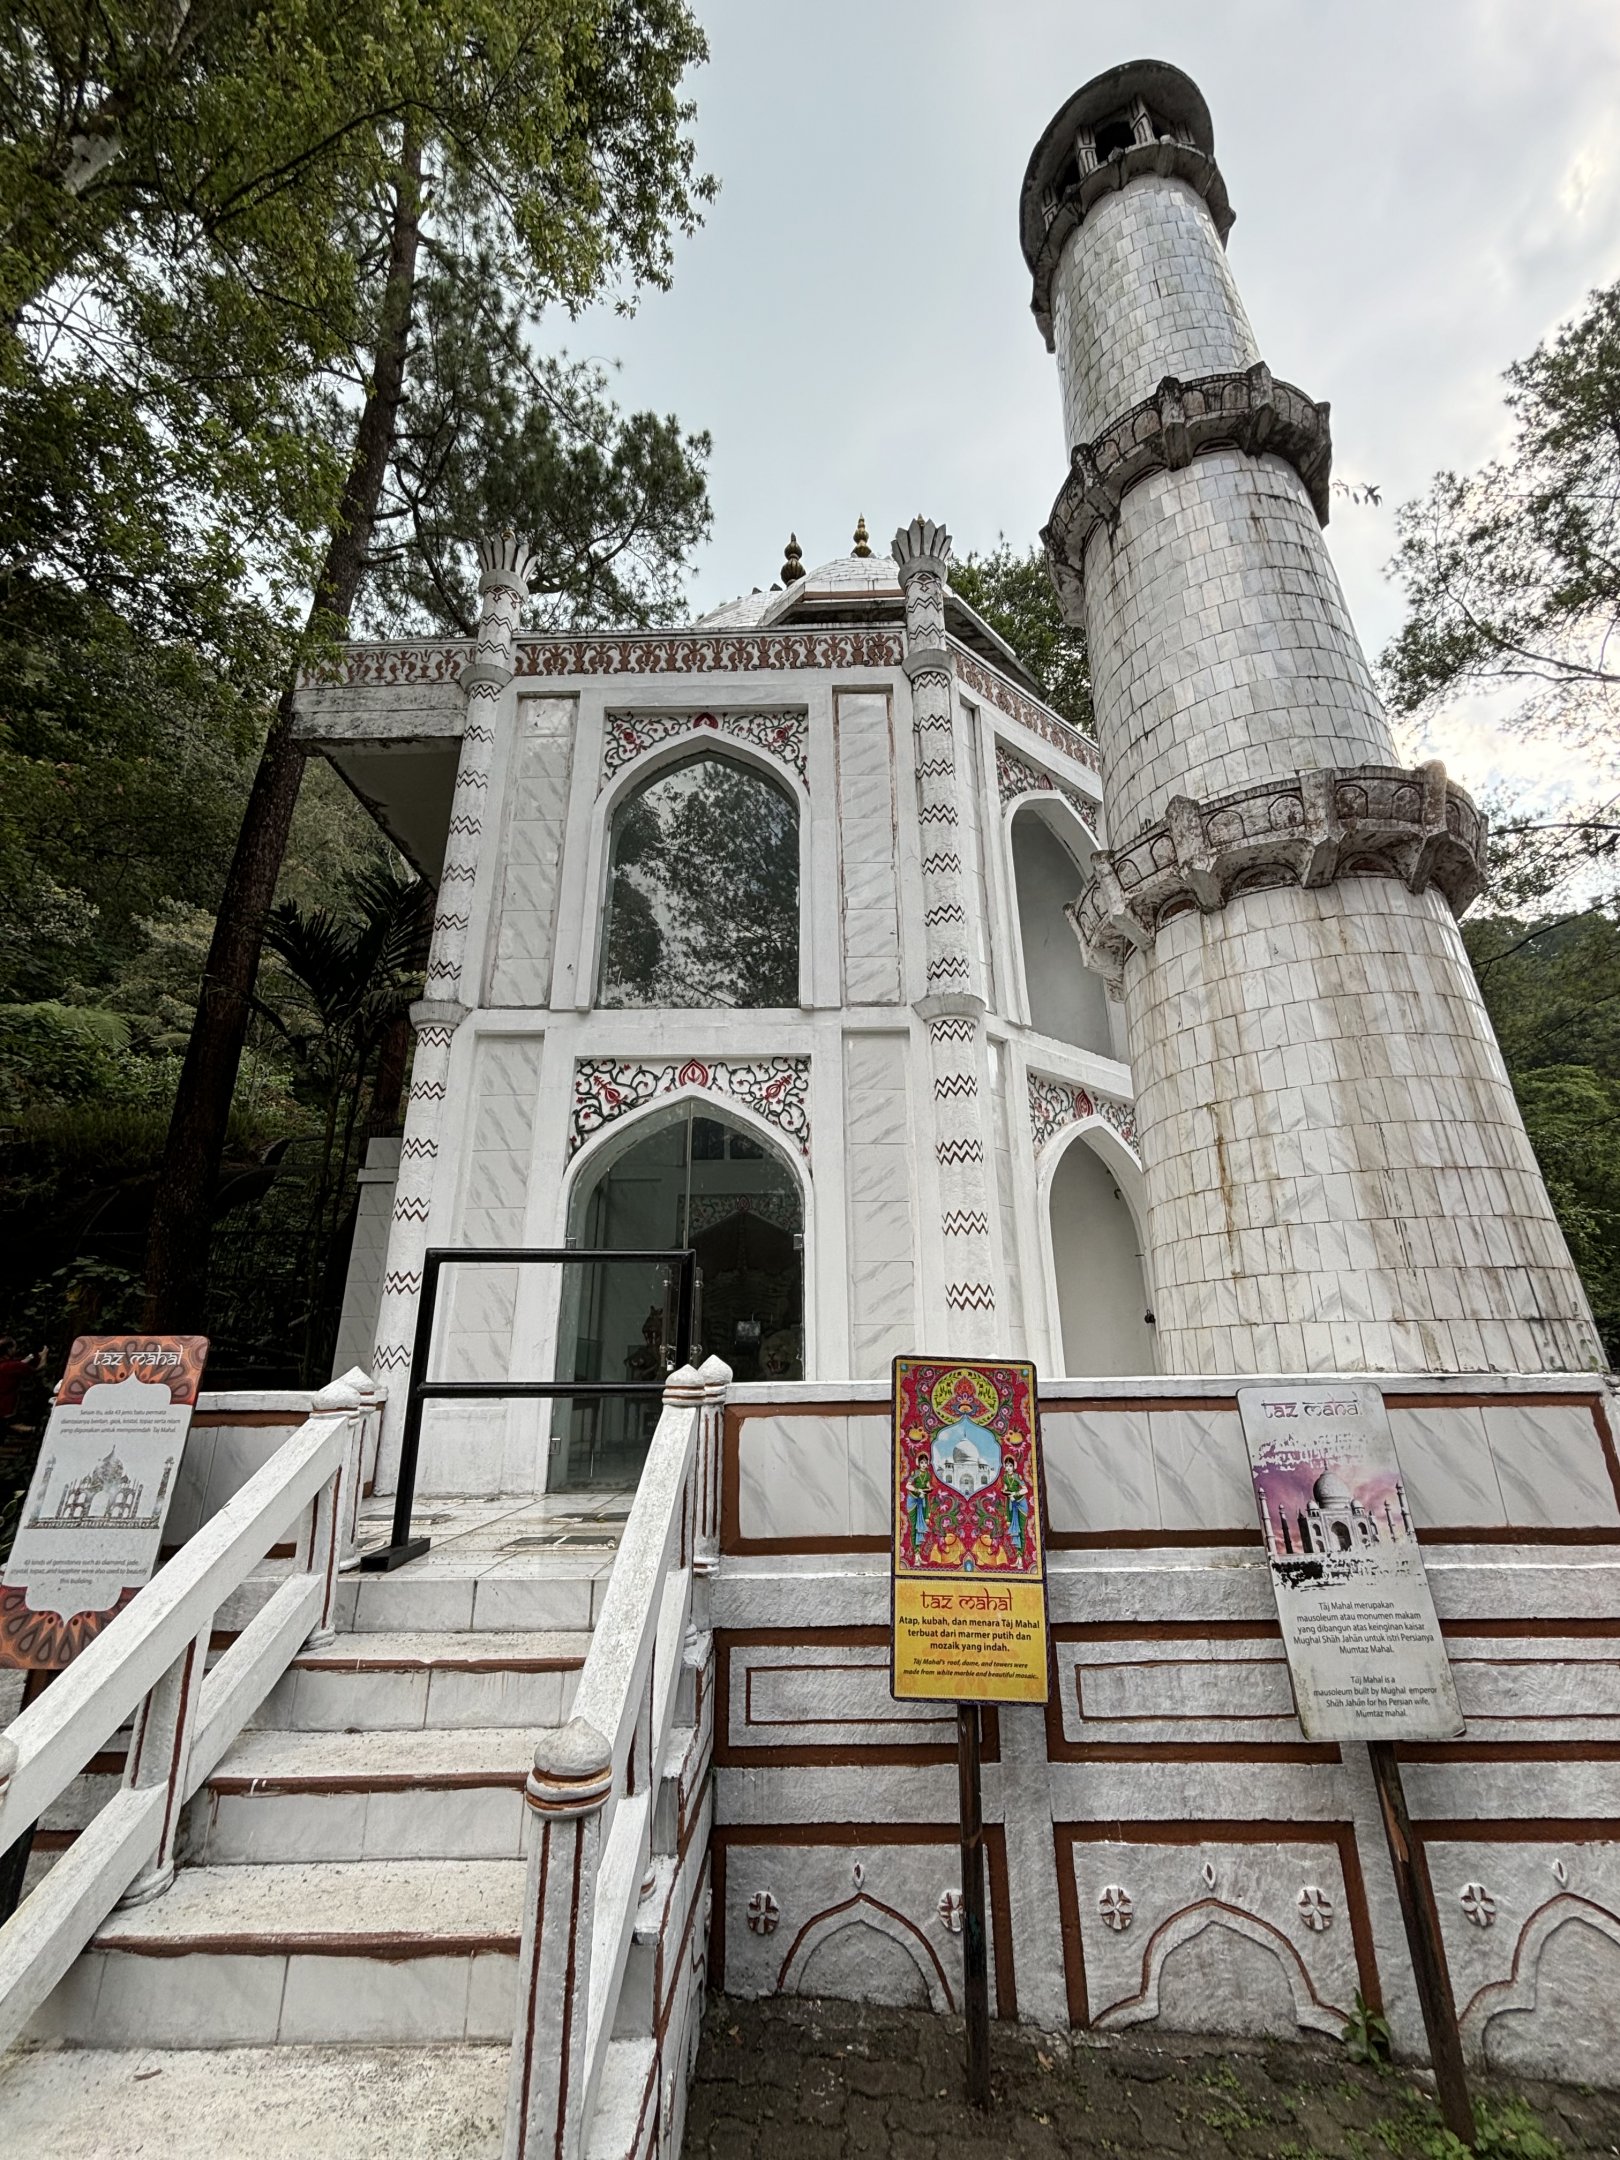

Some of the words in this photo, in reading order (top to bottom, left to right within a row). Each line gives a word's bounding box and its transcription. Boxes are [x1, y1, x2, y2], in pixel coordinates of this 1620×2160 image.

[93, 1350, 126, 1366] taz
[130, 1345, 184, 1366] mahal
[920, 1591, 953, 1609] taz
[959, 1587, 1013, 1611] mahal
[1331, 1602, 1353, 1610] Mahal
[1354, 1601, 1394, 1611] merupakan
[899, 1616, 919, 1626] Atap,
[922, 1616, 949, 1627] kubah,
[952, 1617, 967, 1626] dan
[1015, 1620, 1040, 1629] Mahal
[1297, 1613, 1338, 1622] mausoleum
[1395, 1611, 1421, 1619] makam
[908, 1628, 938, 1637] terbuat
[940, 1629, 956, 1638] dari
[992, 1631, 1014, 1642] putih
[1015, 1632, 1031, 1640] dan
[1297, 1626, 1316, 1635] yang
[1317, 1624, 1351, 1634] dibangun
[1368, 1622, 1403, 1633] keinginan
[1404, 1622, 1425, 1630] kaisar
[1293, 1636, 1320, 1646] Mughal
[1364, 1634, 1385, 1642] untuk
[1400, 1633, 1434, 1643] Persianya
[930, 1642, 960, 1650] mozaik
[961, 1644, 982, 1653] yang
[983, 1643, 1010, 1652] indah.
[1340, 1645, 1369, 1654] Mumtaz
